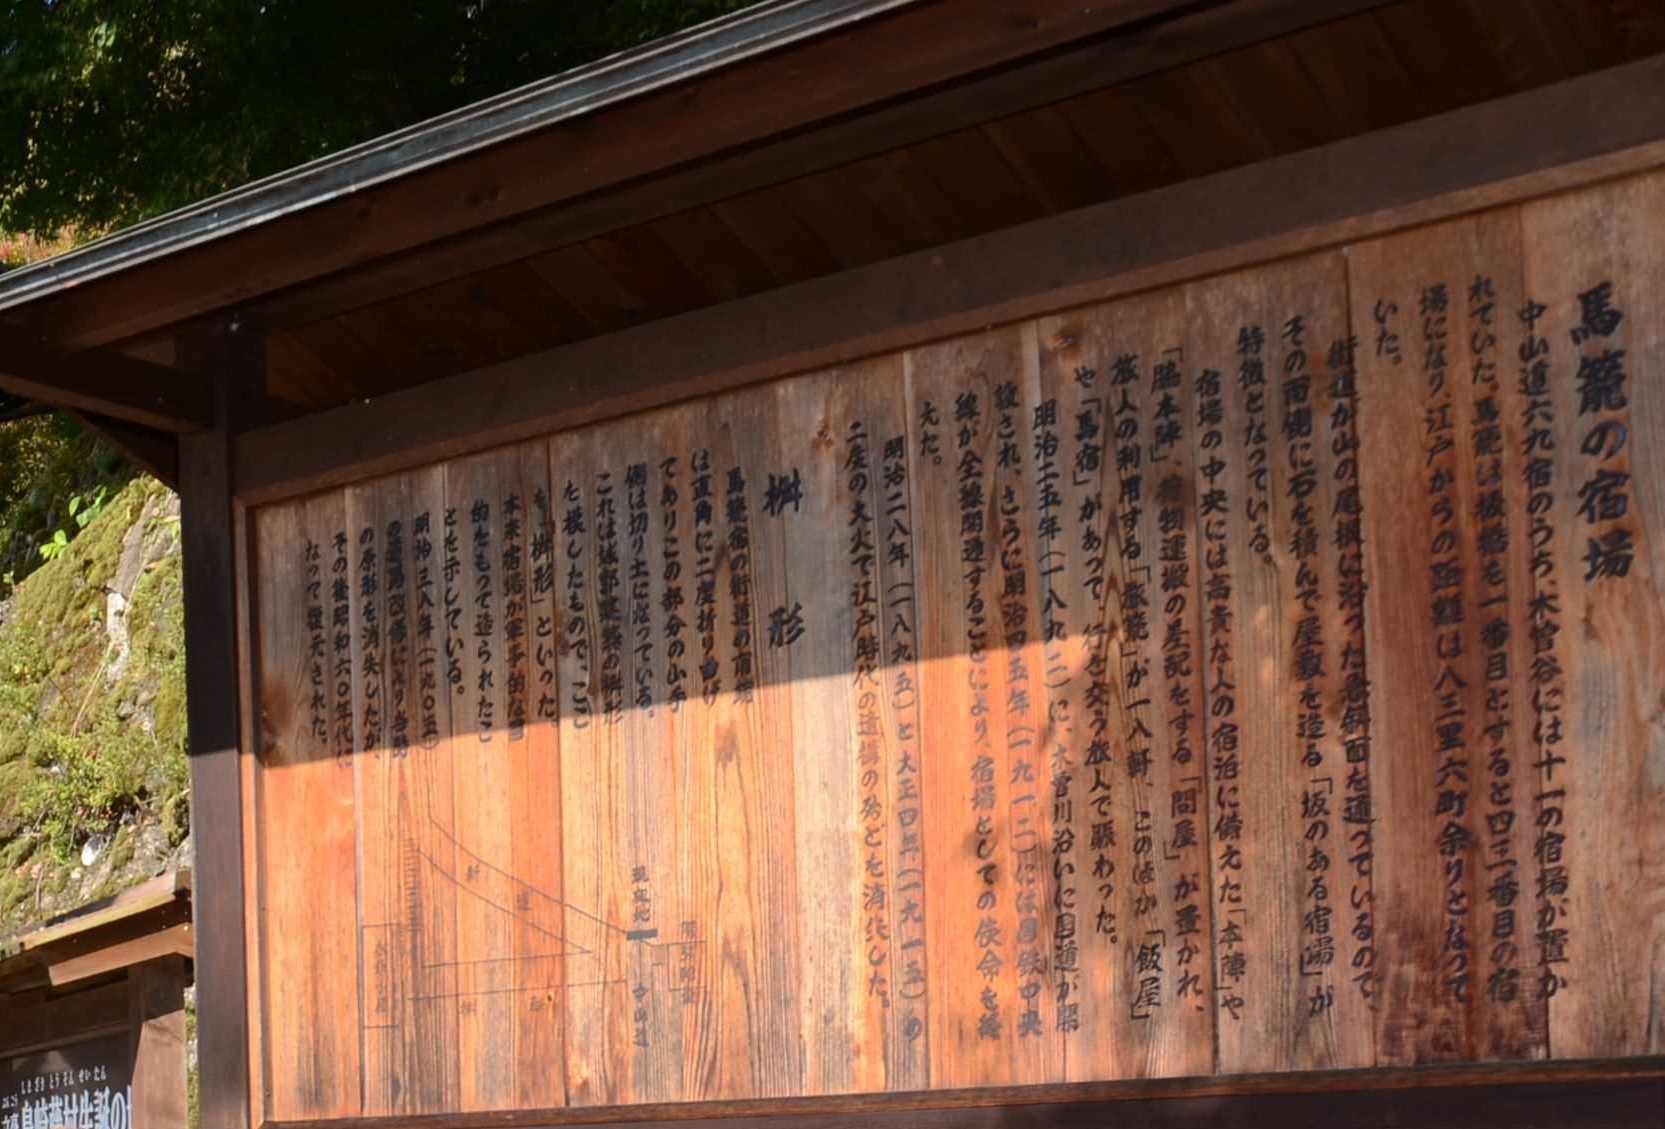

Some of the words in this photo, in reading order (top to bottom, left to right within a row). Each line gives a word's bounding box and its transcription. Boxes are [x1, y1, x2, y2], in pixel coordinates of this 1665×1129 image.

[1375, 299, 1401, 365] いた。
[920, 402, 942, 464] えた。
[1570, 282, 1632, 580] 馬籠の宿場
